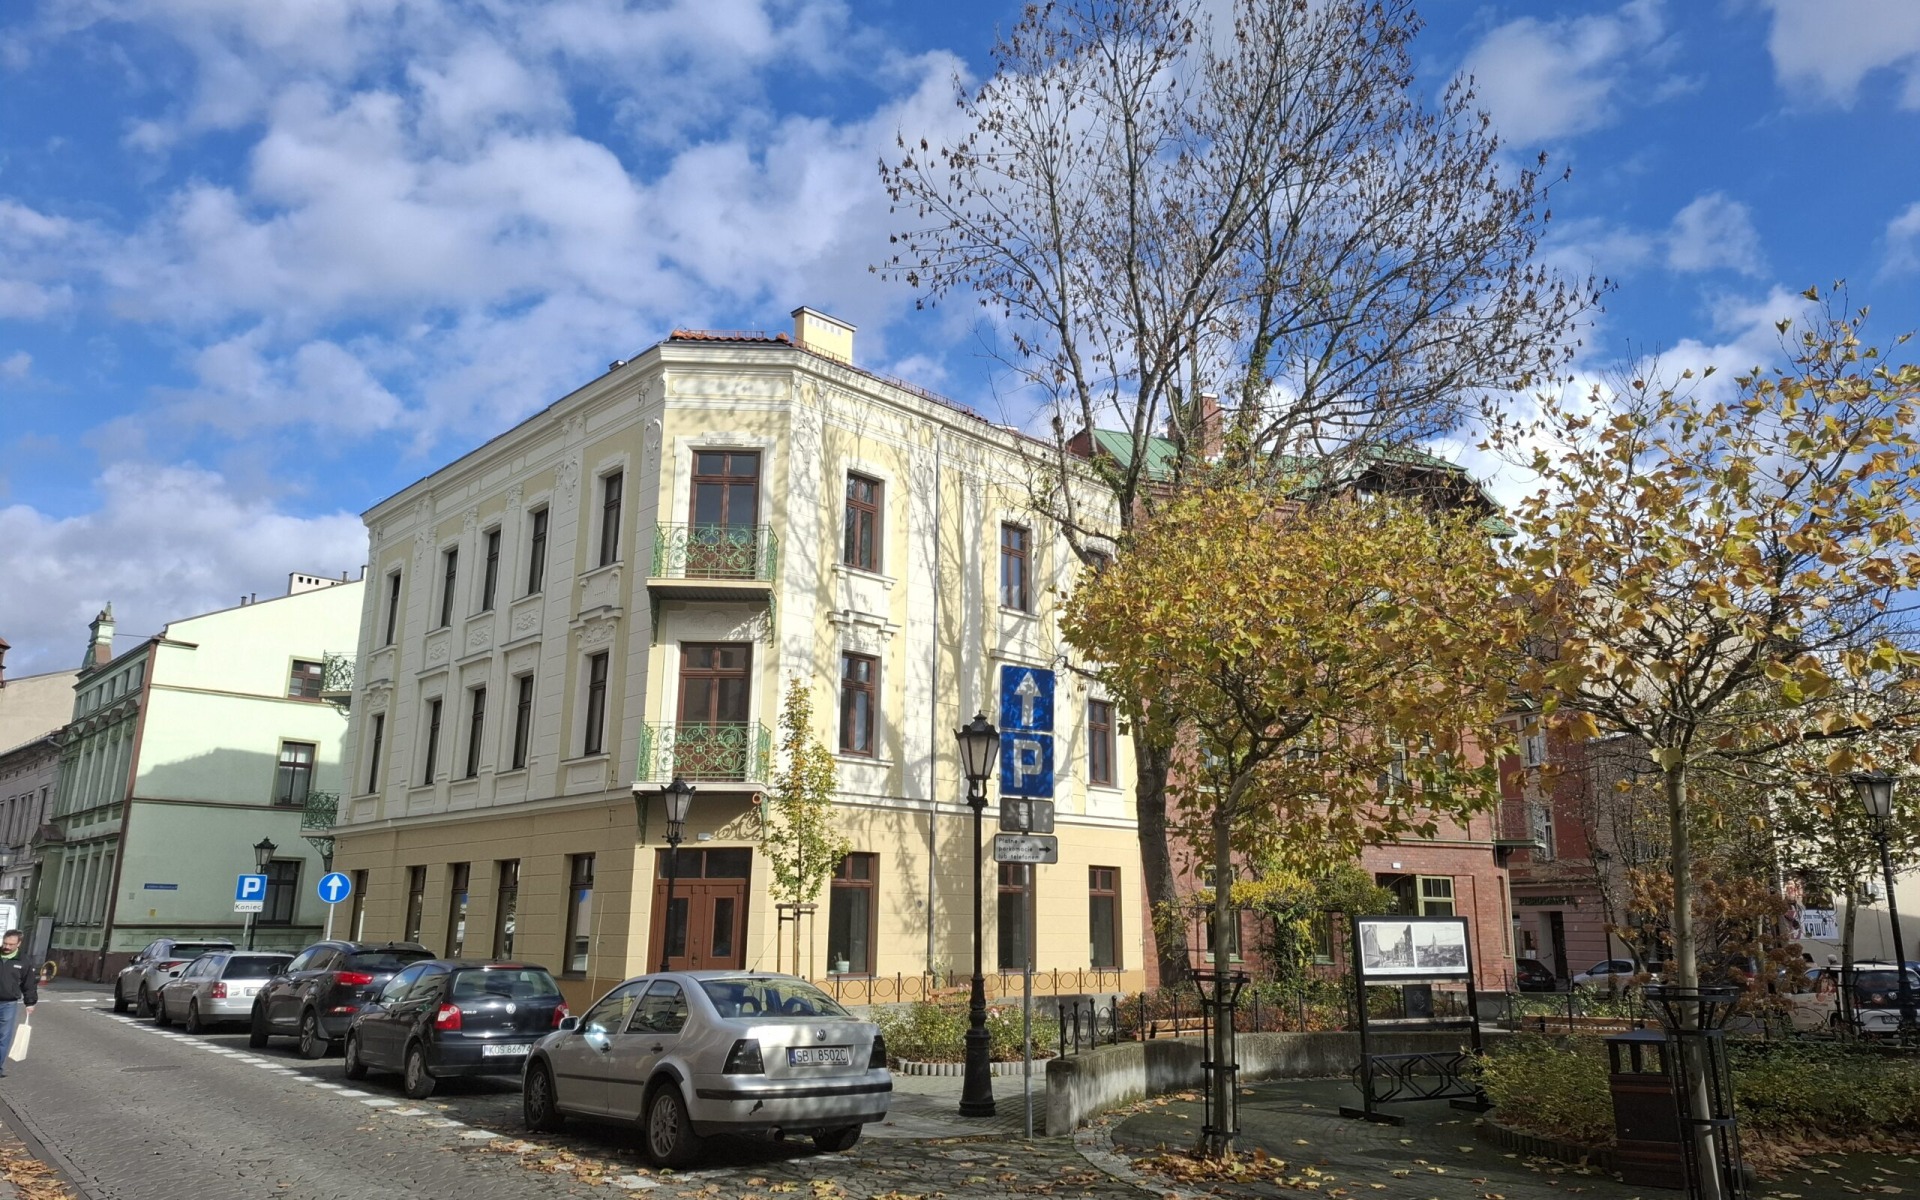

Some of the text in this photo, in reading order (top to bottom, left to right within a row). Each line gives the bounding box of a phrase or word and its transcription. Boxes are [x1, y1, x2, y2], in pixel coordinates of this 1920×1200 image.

[1013, 738, 1043, 788] P
[242, 877, 261, 898] P
[796, 1049, 847, 1062] SBI 8502C
